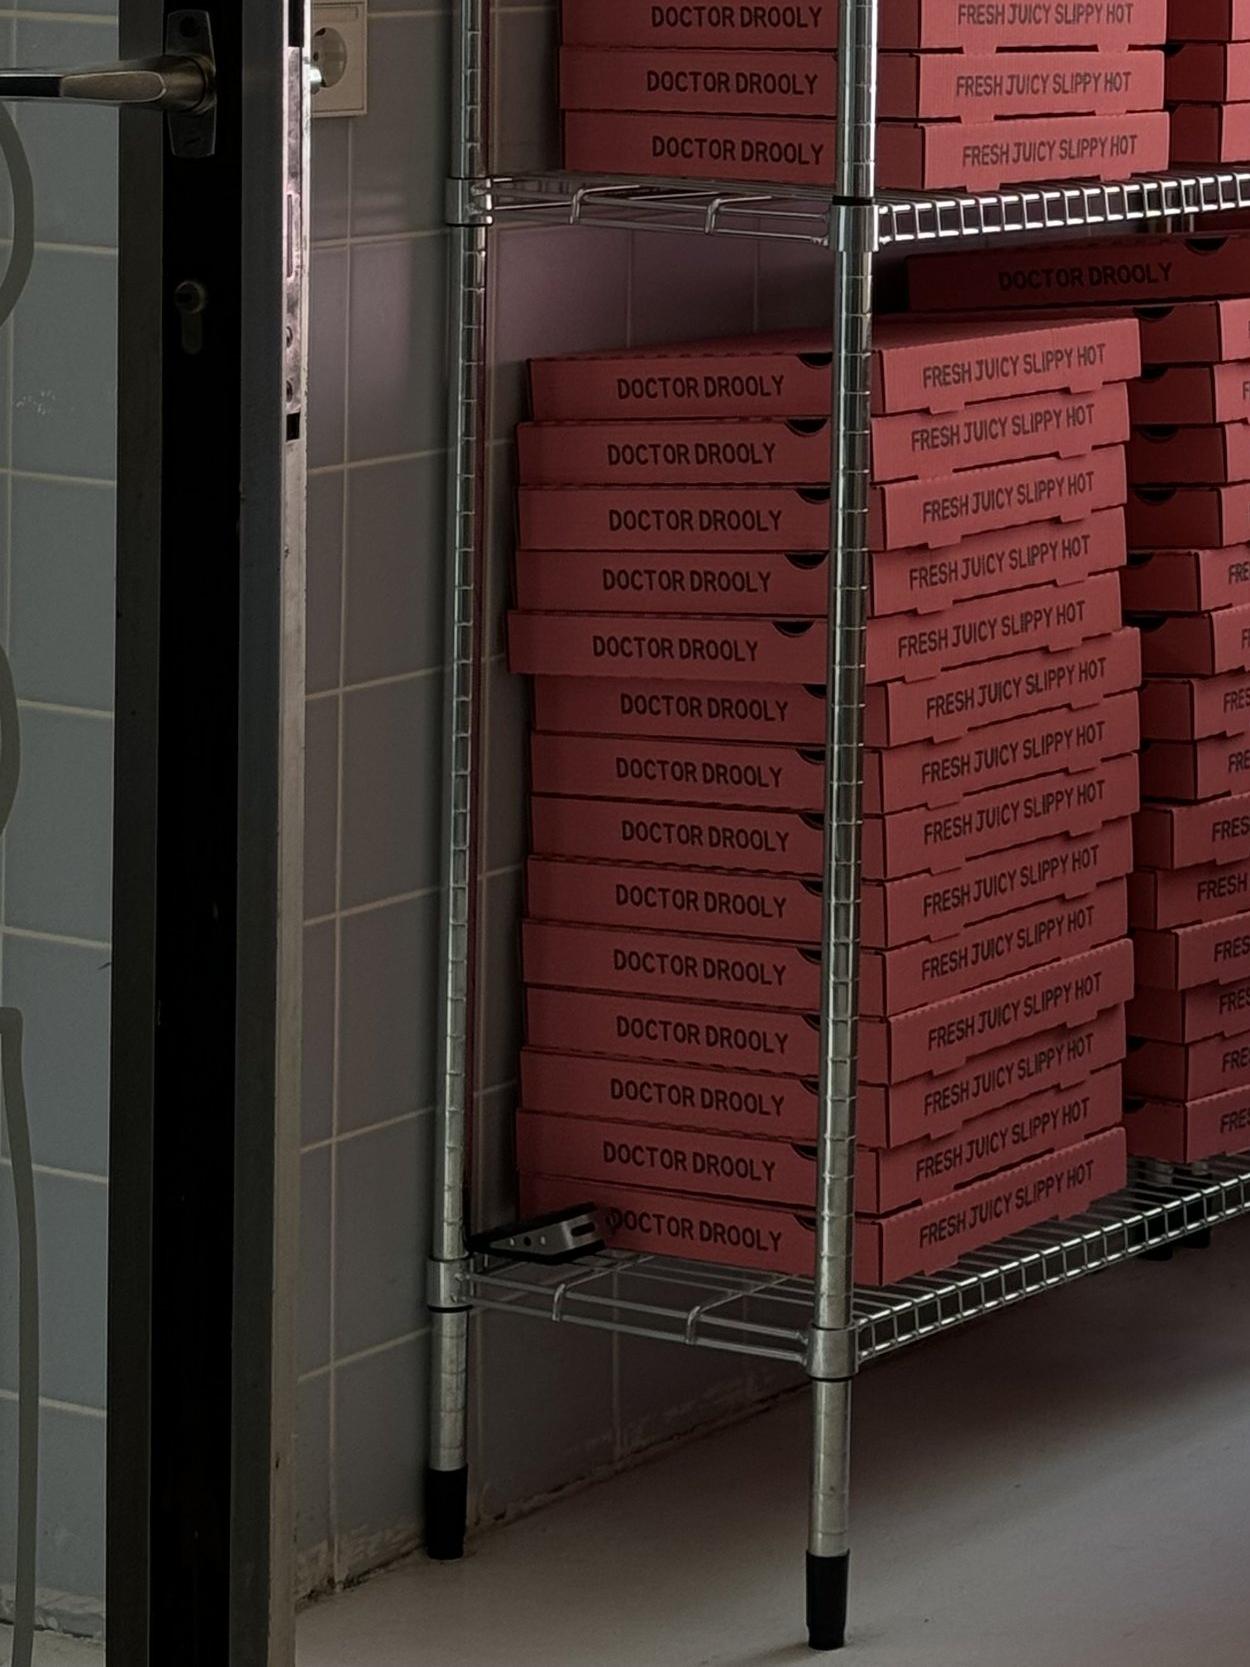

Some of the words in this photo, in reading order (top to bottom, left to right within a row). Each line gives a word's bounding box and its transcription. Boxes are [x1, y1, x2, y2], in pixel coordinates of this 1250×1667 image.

[957, 2, 1006, 26] FRESH
[1007, 2, 1052, 25] JUICY
[1054, 2, 1103, 26] SLIPPY
[1105, 2, 1135, 24] HOT
[652, 135, 736, 161] DOCTOR
[741, 139, 825, 167] DROOLY
[962, 142, 1010, 167] FRESH
[1011, 139, 1057, 164] JUICY
[1058, 135, 1108, 161] SLIPPY
[1109, 133, 1139, 157] HOT
[998, 267, 1084, 291] DOCTOR
[1087, 262, 1173, 287] DROOLY
[922, 361, 972, 389] FRESH
[975, 355, 1020, 382] JUICY
[1022, 348, 1074, 376] SLIPPY
[1076, 342, 1105, 368] HOT
[616, 376, 700, 400] DOCTOR
[703, 375, 785, 399] DROOLY
[608, 509, 694, 532] DOCTOR
[698, 509, 783, 532] DROOLY
[909, 559, 959, 590] FRESH
[961, 550, 1005, 581] JUICY
[1008, 540, 1058, 572] SLIPPY
[1061, 533, 1089, 561] HOT
[592, 635, 675, 660] DOCTOR
[678, 638, 759, 662] DROOLY
[621, 820, 704, 847] DOCTOR
[707, 825, 790, 854] DROOLY
[921, 946, 969, 982] FRESH
[970, 931, 1014, 966] JUICY
[1016, 914, 1065, 951] SLIPPY
[1067, 905, 1093, 934] HOT
[616, 1015, 701, 1046] DOCTOR
[705, 1024, 790, 1055] DROOLY
[603, 1141, 688, 1172] DOCTOR
[692, 1151, 777, 1183] DROOLY
[919, 1209, 967, 1249] FRESH
[968, 1192, 1013, 1230] JUICY
[1015, 1171, 1064, 1211] SLIPPY
[1066, 1160, 1093, 1190] HOT
